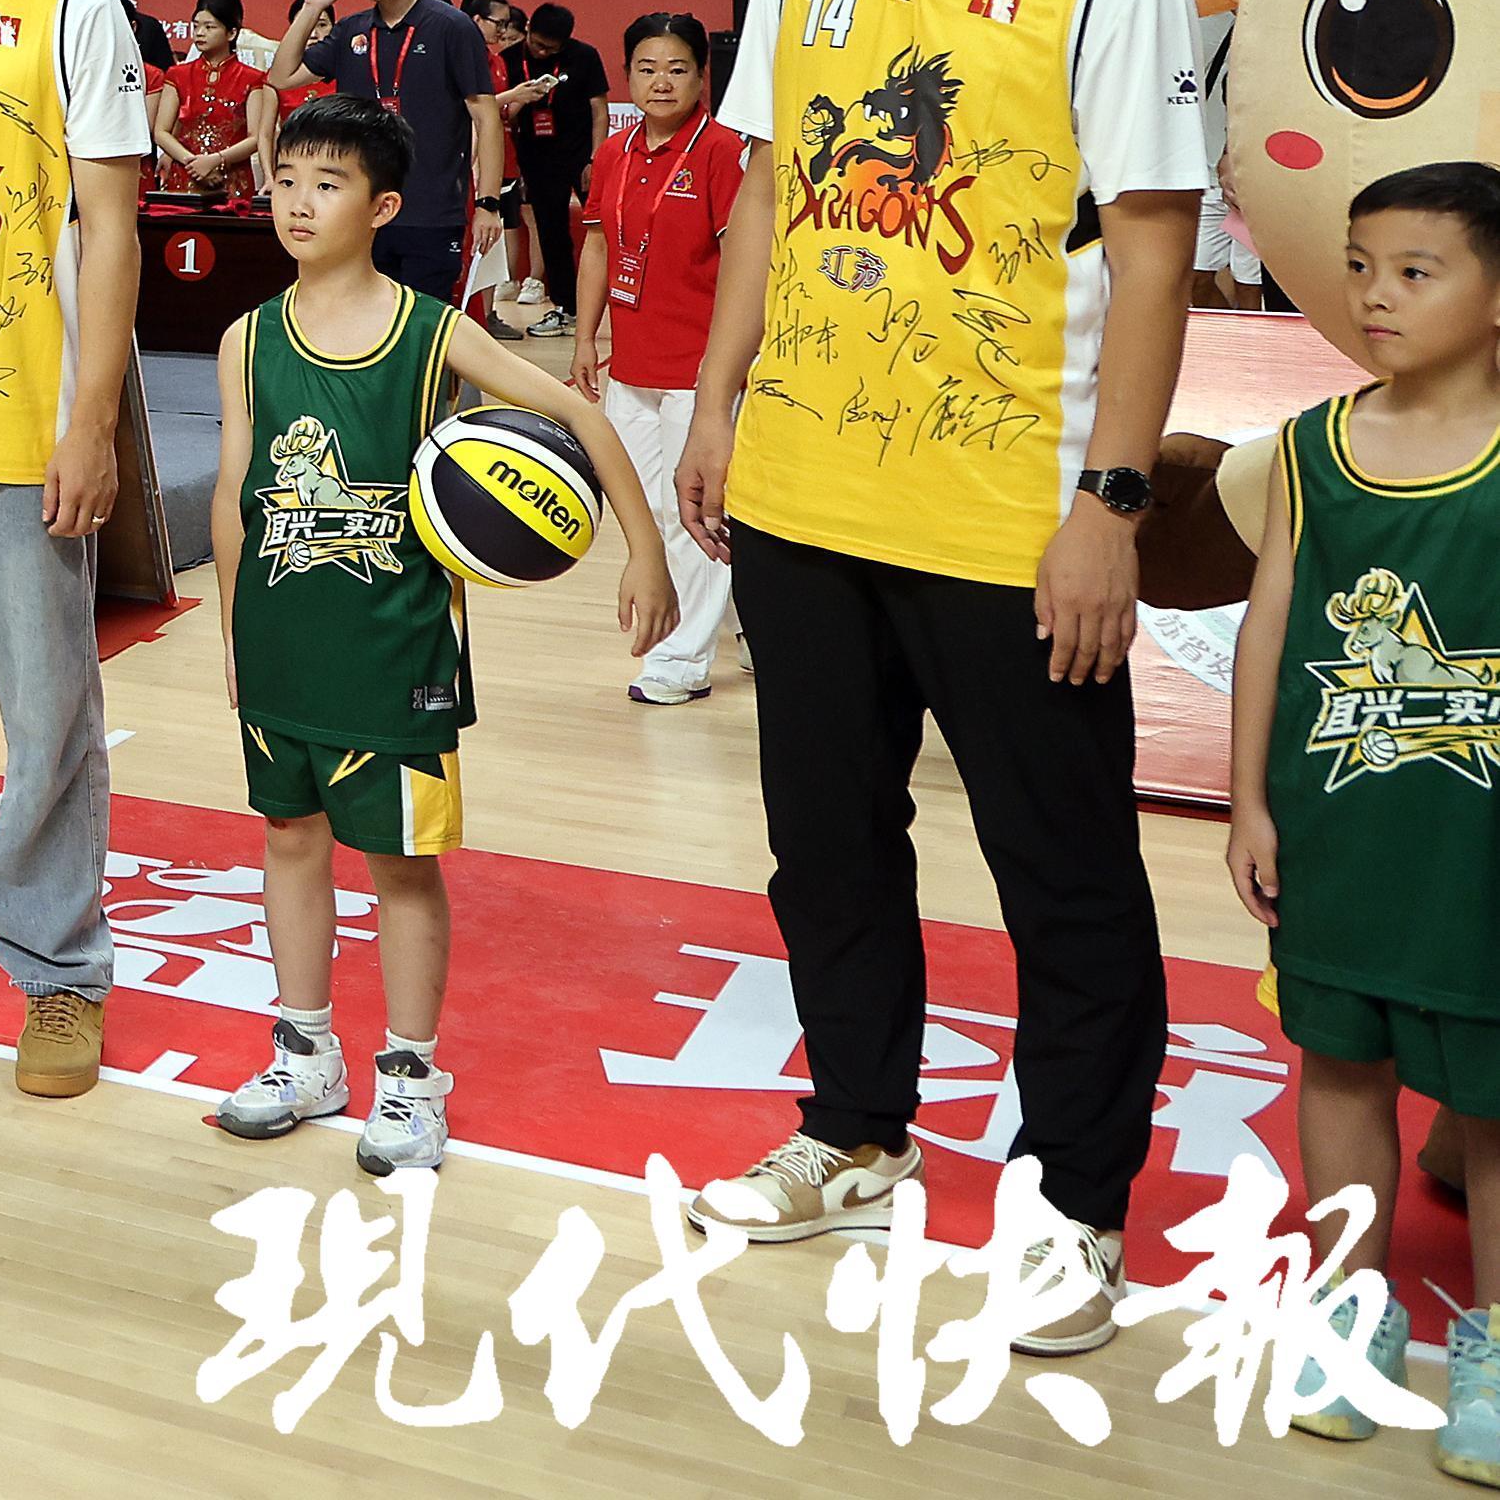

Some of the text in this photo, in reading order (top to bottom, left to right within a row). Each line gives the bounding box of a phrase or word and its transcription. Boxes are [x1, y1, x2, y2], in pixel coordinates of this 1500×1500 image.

[118, 84, 143, 94] KELM
[785, 149, 979, 275] DRAGONS
[177, 237, 201, 275] 1
[821, 246, 889, 291] 江苏
[487, 459, 585, 541] molten
[267, 510, 405, 547] 宜兴二实小
